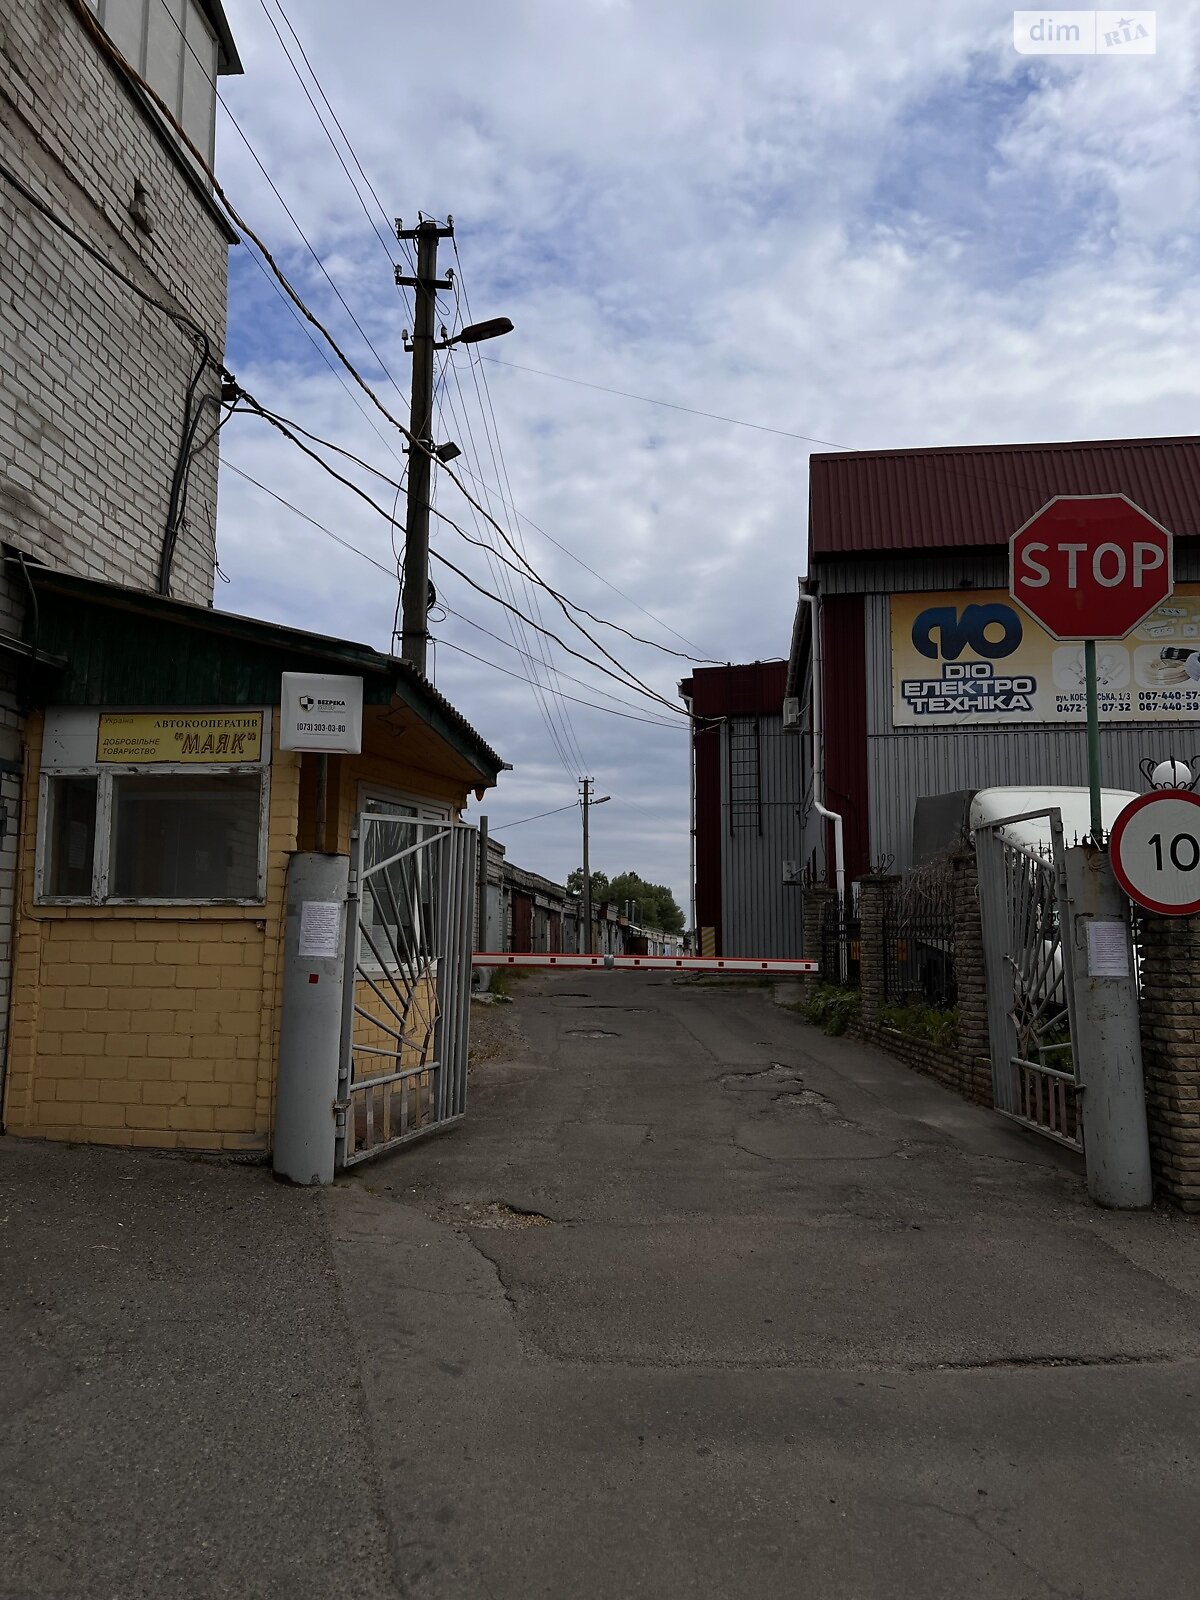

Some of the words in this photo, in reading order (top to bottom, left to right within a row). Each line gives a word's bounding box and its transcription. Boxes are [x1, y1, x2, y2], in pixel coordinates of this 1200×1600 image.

[1020, 542, 1165, 589] STOP
[904, 678, 1033, 697] ЕЛЕКТРО
[910, 695, 1030, 712] ТЕХНІКА
[1055, 694, 1068, 703] вул.
[1118, 692, 1131, 701] 1/3
[153, 719, 258, 729] АВТОКООПЕРАТИВ
[296, 722, 313, 732] (073)
[102, 738, 161, 746] ДОБРОВІЛЬНЕ
[174, 732, 257, 755] "МАЯК"
[102, 747, 156, 755] ТОВАРИСТВО
[1148, 832, 1200, 873] 10
